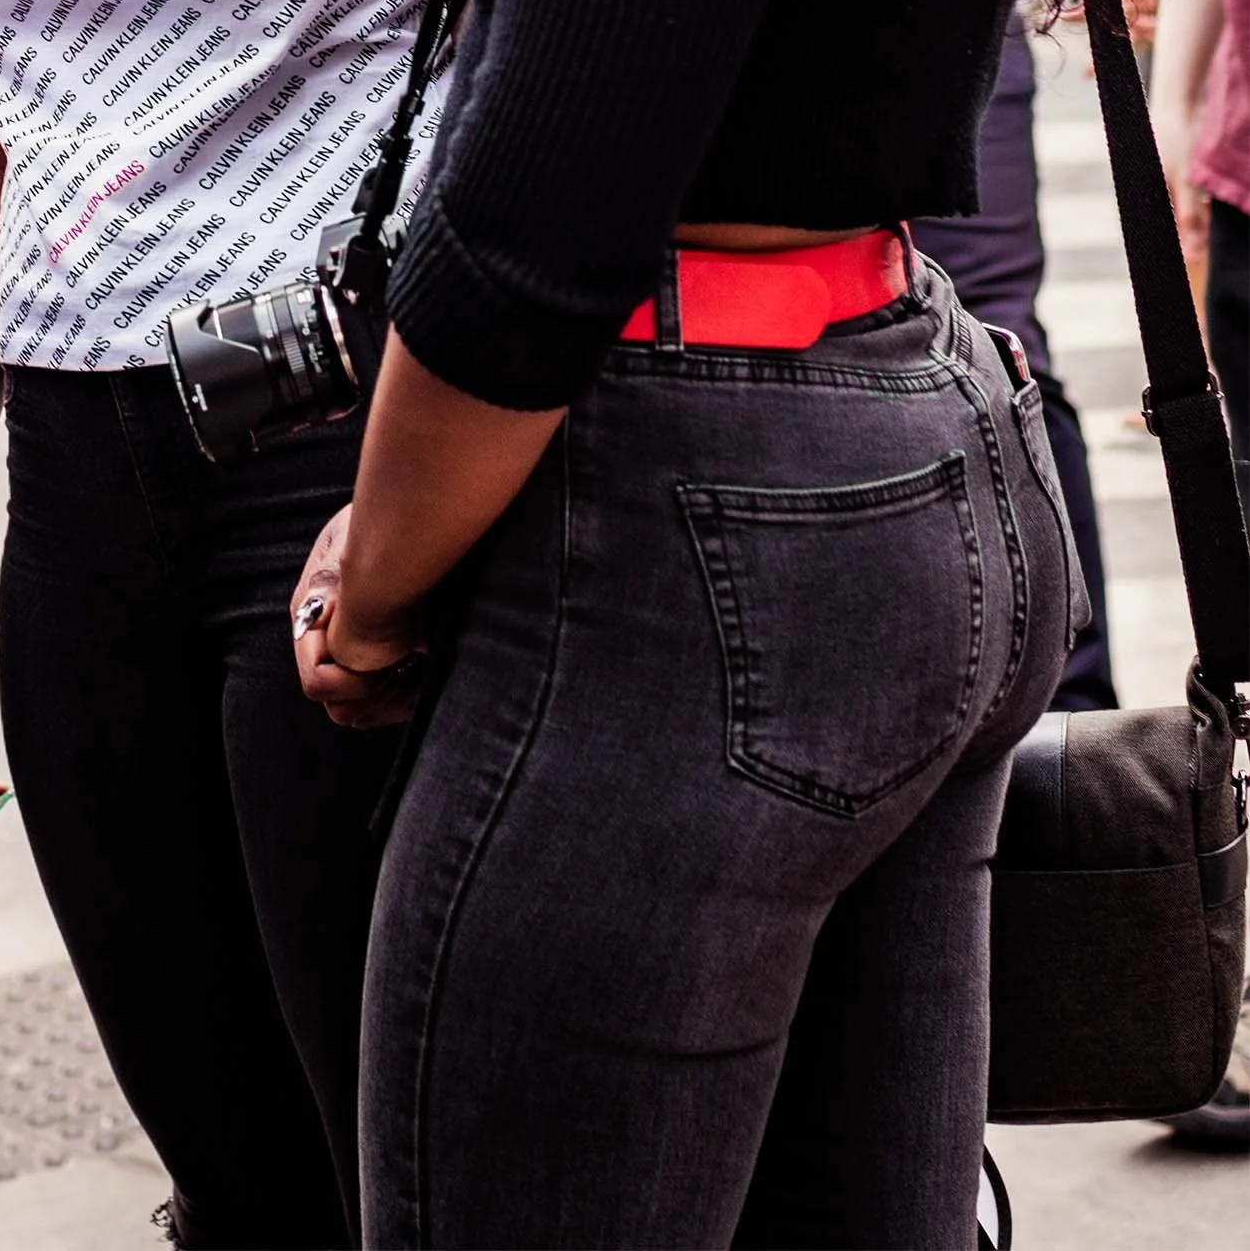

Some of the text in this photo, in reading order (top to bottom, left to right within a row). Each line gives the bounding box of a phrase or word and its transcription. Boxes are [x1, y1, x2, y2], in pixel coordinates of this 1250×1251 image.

[40, 2, 71, 43] CALVIN
[62, 22, 99, 64] CALVIN
[82, 43, 121, 86] CALVIN
[115, 14, 149, 50] KLEIN
[287, 16, 337, 58] CALVIN
[13, 46, 38, 83] JEANS
[102, 7, 202, 107] CALVIN KLEIN JEANS
[124, 25, 231, 127] CALVIN KLEIN JEANS
[338, 42, 378, 85] CALVIN
[365, 65, 407, 104] CALVIN
[4, 67, 57, 125] KLEIN JEANS
[46, 89, 77, 127] JEANS
[148, 93, 238, 159] CALVIN KLEIN
[173, 128, 213, 175] CALVIN
[198, 143, 244, 191] CALVIN
[234, 111, 275, 148] KLEIN
[267, 74, 307, 117] JEANS
[228, 162, 274, 208] CALVIN
[265, 127, 306, 167] KLEIN
[298, 91, 337, 132] JEANS
[41, 149, 71, 186] KLEIN
[58, 142, 121, 209] KLEIN JEANS
[259, 110, 366, 225] CALVIN KLEIN JEANS
[48, 159, 145, 264] CALVIN KLEIN JEANS
[289, 196, 335, 242] CALVIN
[326, 162, 365, 201] KLEIN
[65, 181, 167, 289] CALVIN KLEIN JEANS
[85, 198, 196, 311] CALVIN KLEIN JEANS
[0, 273, 20, 305] KLEIN
[9, 296, 35, 330] KLEIN
[23, 268, 53, 305] JEANS
[113, 213, 226, 329] CALVIN KLEIN JEANS
[181, 231, 257, 306] KLEIN JEANS
[246, 248, 287, 291] JEANS
[26, 291, 66, 353] KLEIN JEANS
[63, 313, 86, 351] JEANS
[82, 336, 111, 371] JEANS
